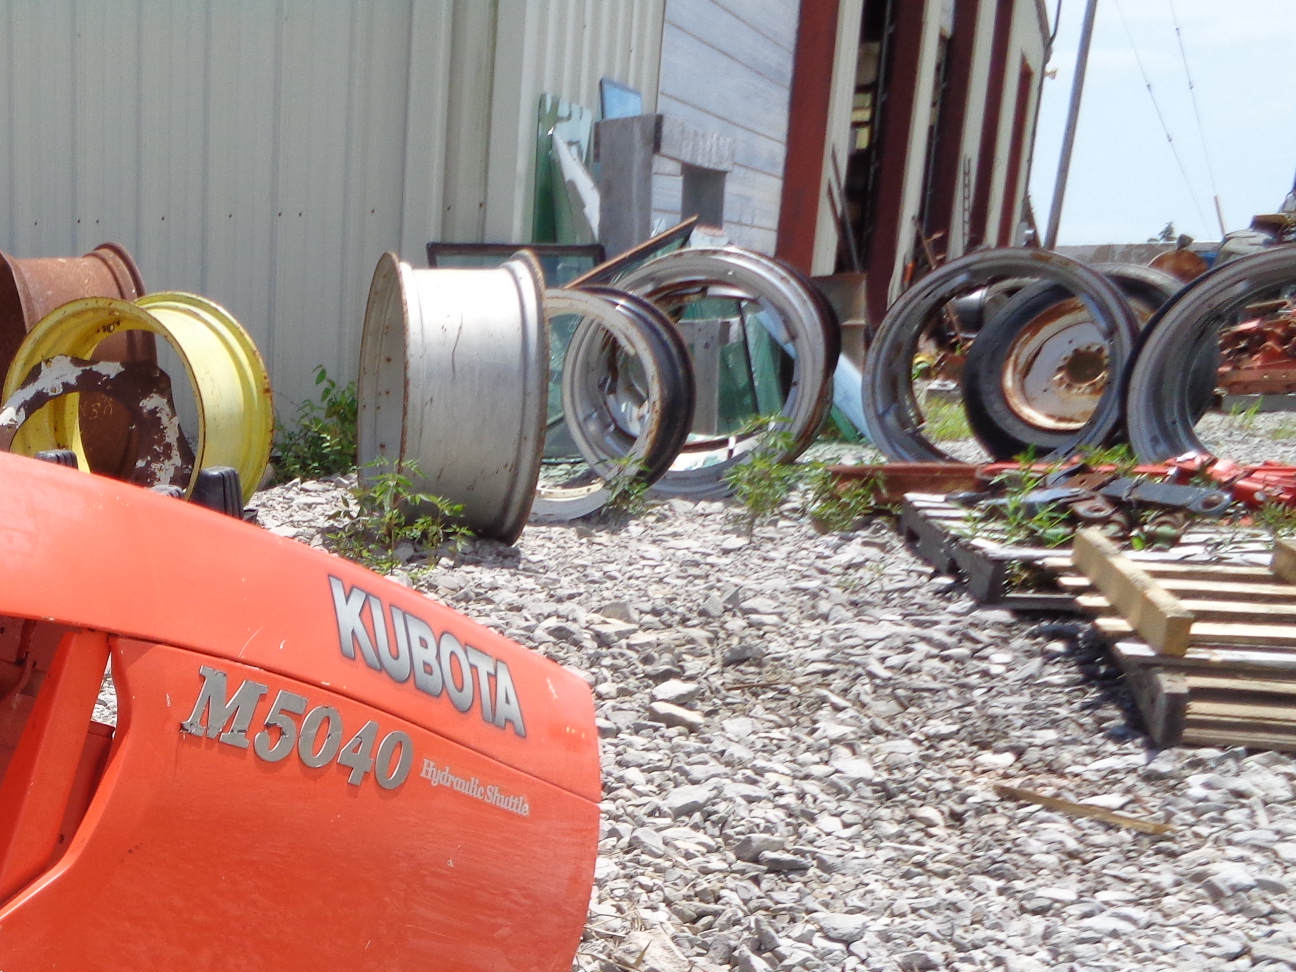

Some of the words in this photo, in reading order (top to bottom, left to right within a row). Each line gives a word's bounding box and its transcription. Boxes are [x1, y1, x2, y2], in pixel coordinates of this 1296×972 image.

[328, 574, 528, 739] KUBOTA
[179, 664, 415, 791] M5040
[419, 758, 485, 800] Hydraulic
[484, 784, 530, 817] Shuttle
